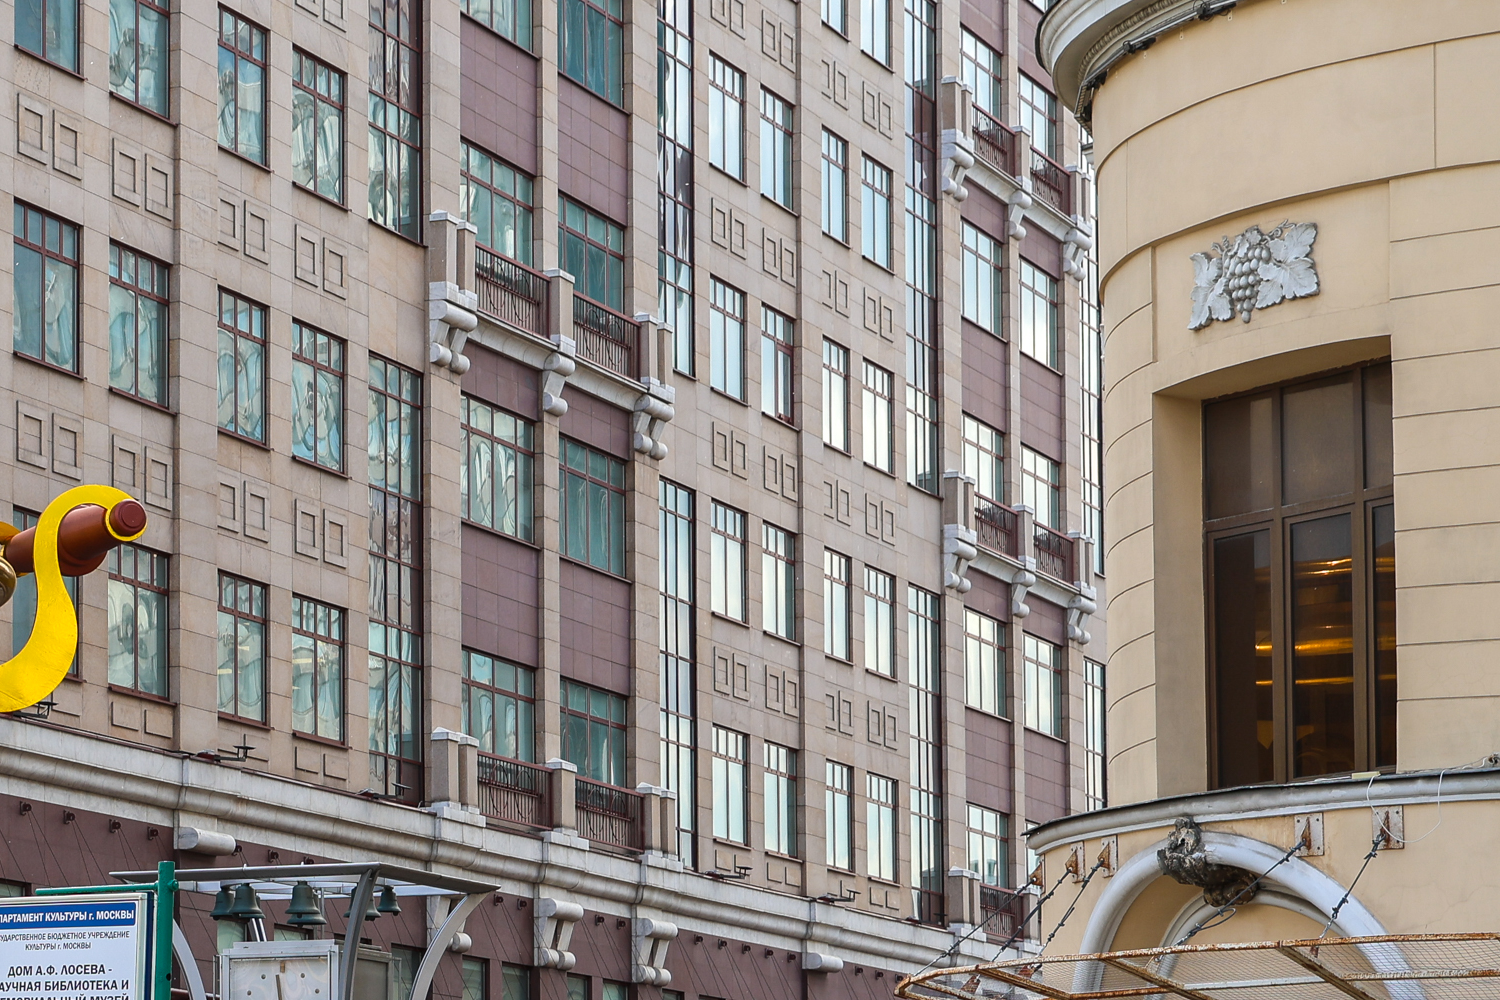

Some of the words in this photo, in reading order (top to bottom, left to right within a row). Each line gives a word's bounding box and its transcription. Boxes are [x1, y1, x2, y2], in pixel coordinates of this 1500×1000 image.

[45, 911, 87, 922] КУЛЬТУРЫ
[89, 913, 94, 921] г.
[96, 910, 134, 920] МОСКВЫ
[47, 932, 86, 942] БЮДЖЕТНОЕ
[88, 931, 130, 940] УЧРЕЖДЕНИЕ
[25, 943, 56, 951] КУЛЬТУРЫ
[63, 942, 91, 950] МОСКВЫ
[8, 966, 33, 978] ДОМ
[36, 965, 58, 976] А.Ф.
[61, 964, 106, 975] ЛОСЕВА
[44, 980, 118, 992] БИБЛИОТЕКА
[121, 980, 129, 990] И
